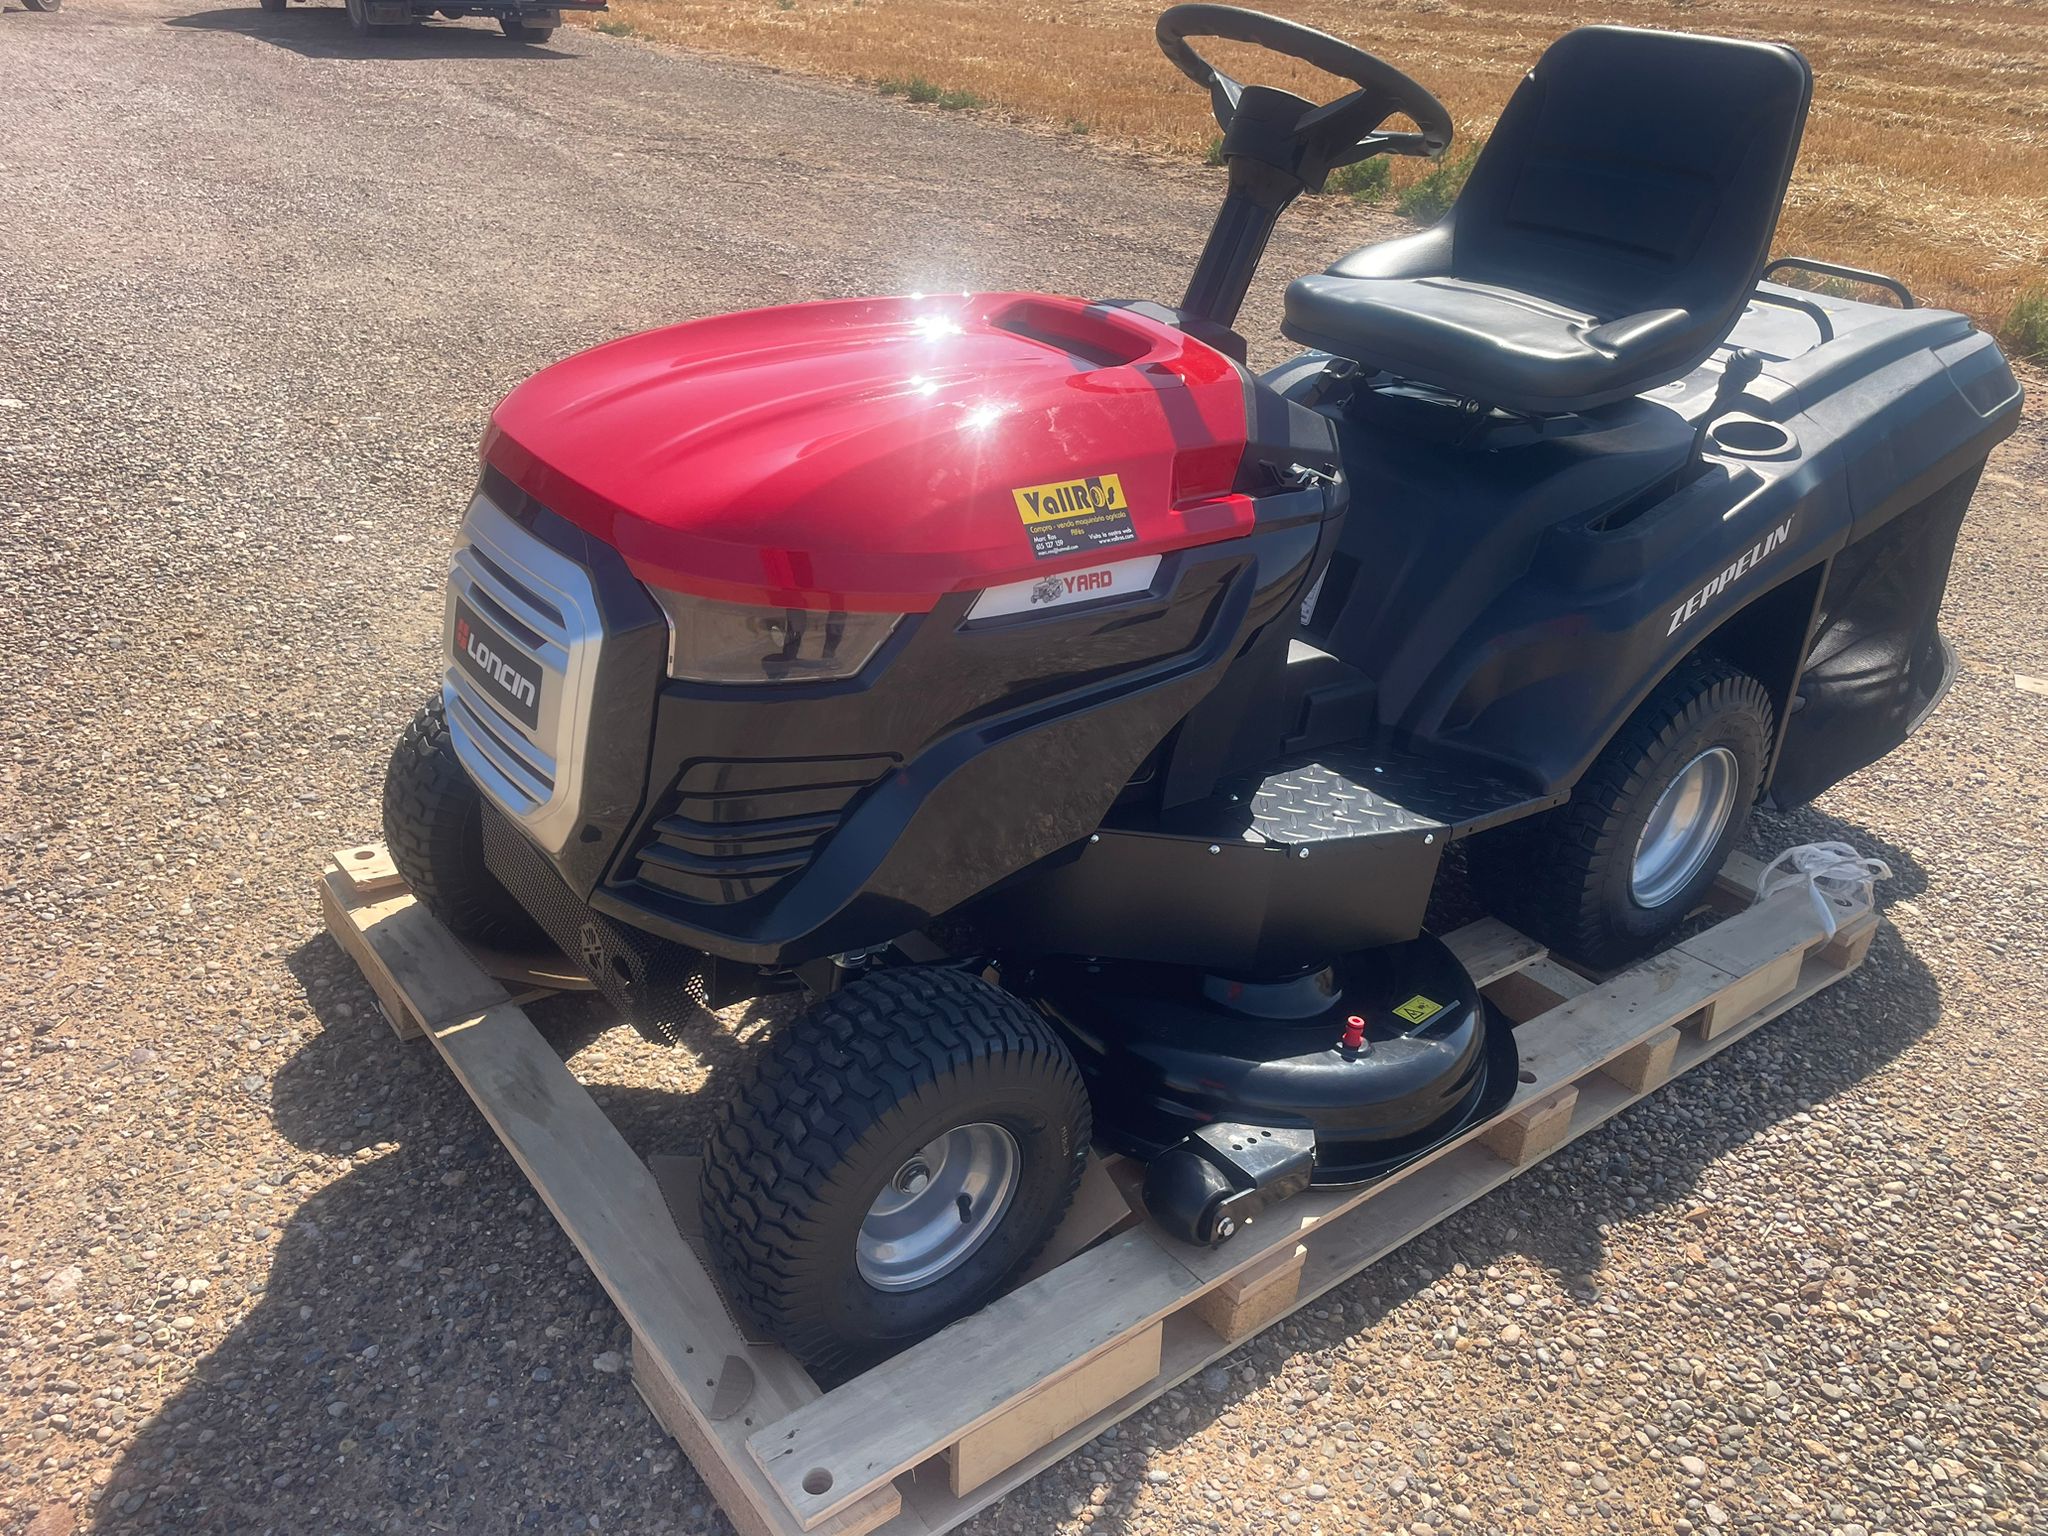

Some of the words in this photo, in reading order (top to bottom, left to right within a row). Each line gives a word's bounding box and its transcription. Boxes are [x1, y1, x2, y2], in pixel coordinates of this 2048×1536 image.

[1023, 486, 1115, 517] VallRos
[1030, 525, 1053, 535] Compra
[1057, 519, 1075, 529] venda
[1033, 535, 1046, 543] Marc
[1047, 533, 1057, 541] Ros
[1102, 531, 1108, 539] la
[1063, 570, 1113, 594] YARD
[1666, 517, 1792, 637] ZEPPELIN
[467, 632, 536, 708] LONCIN
